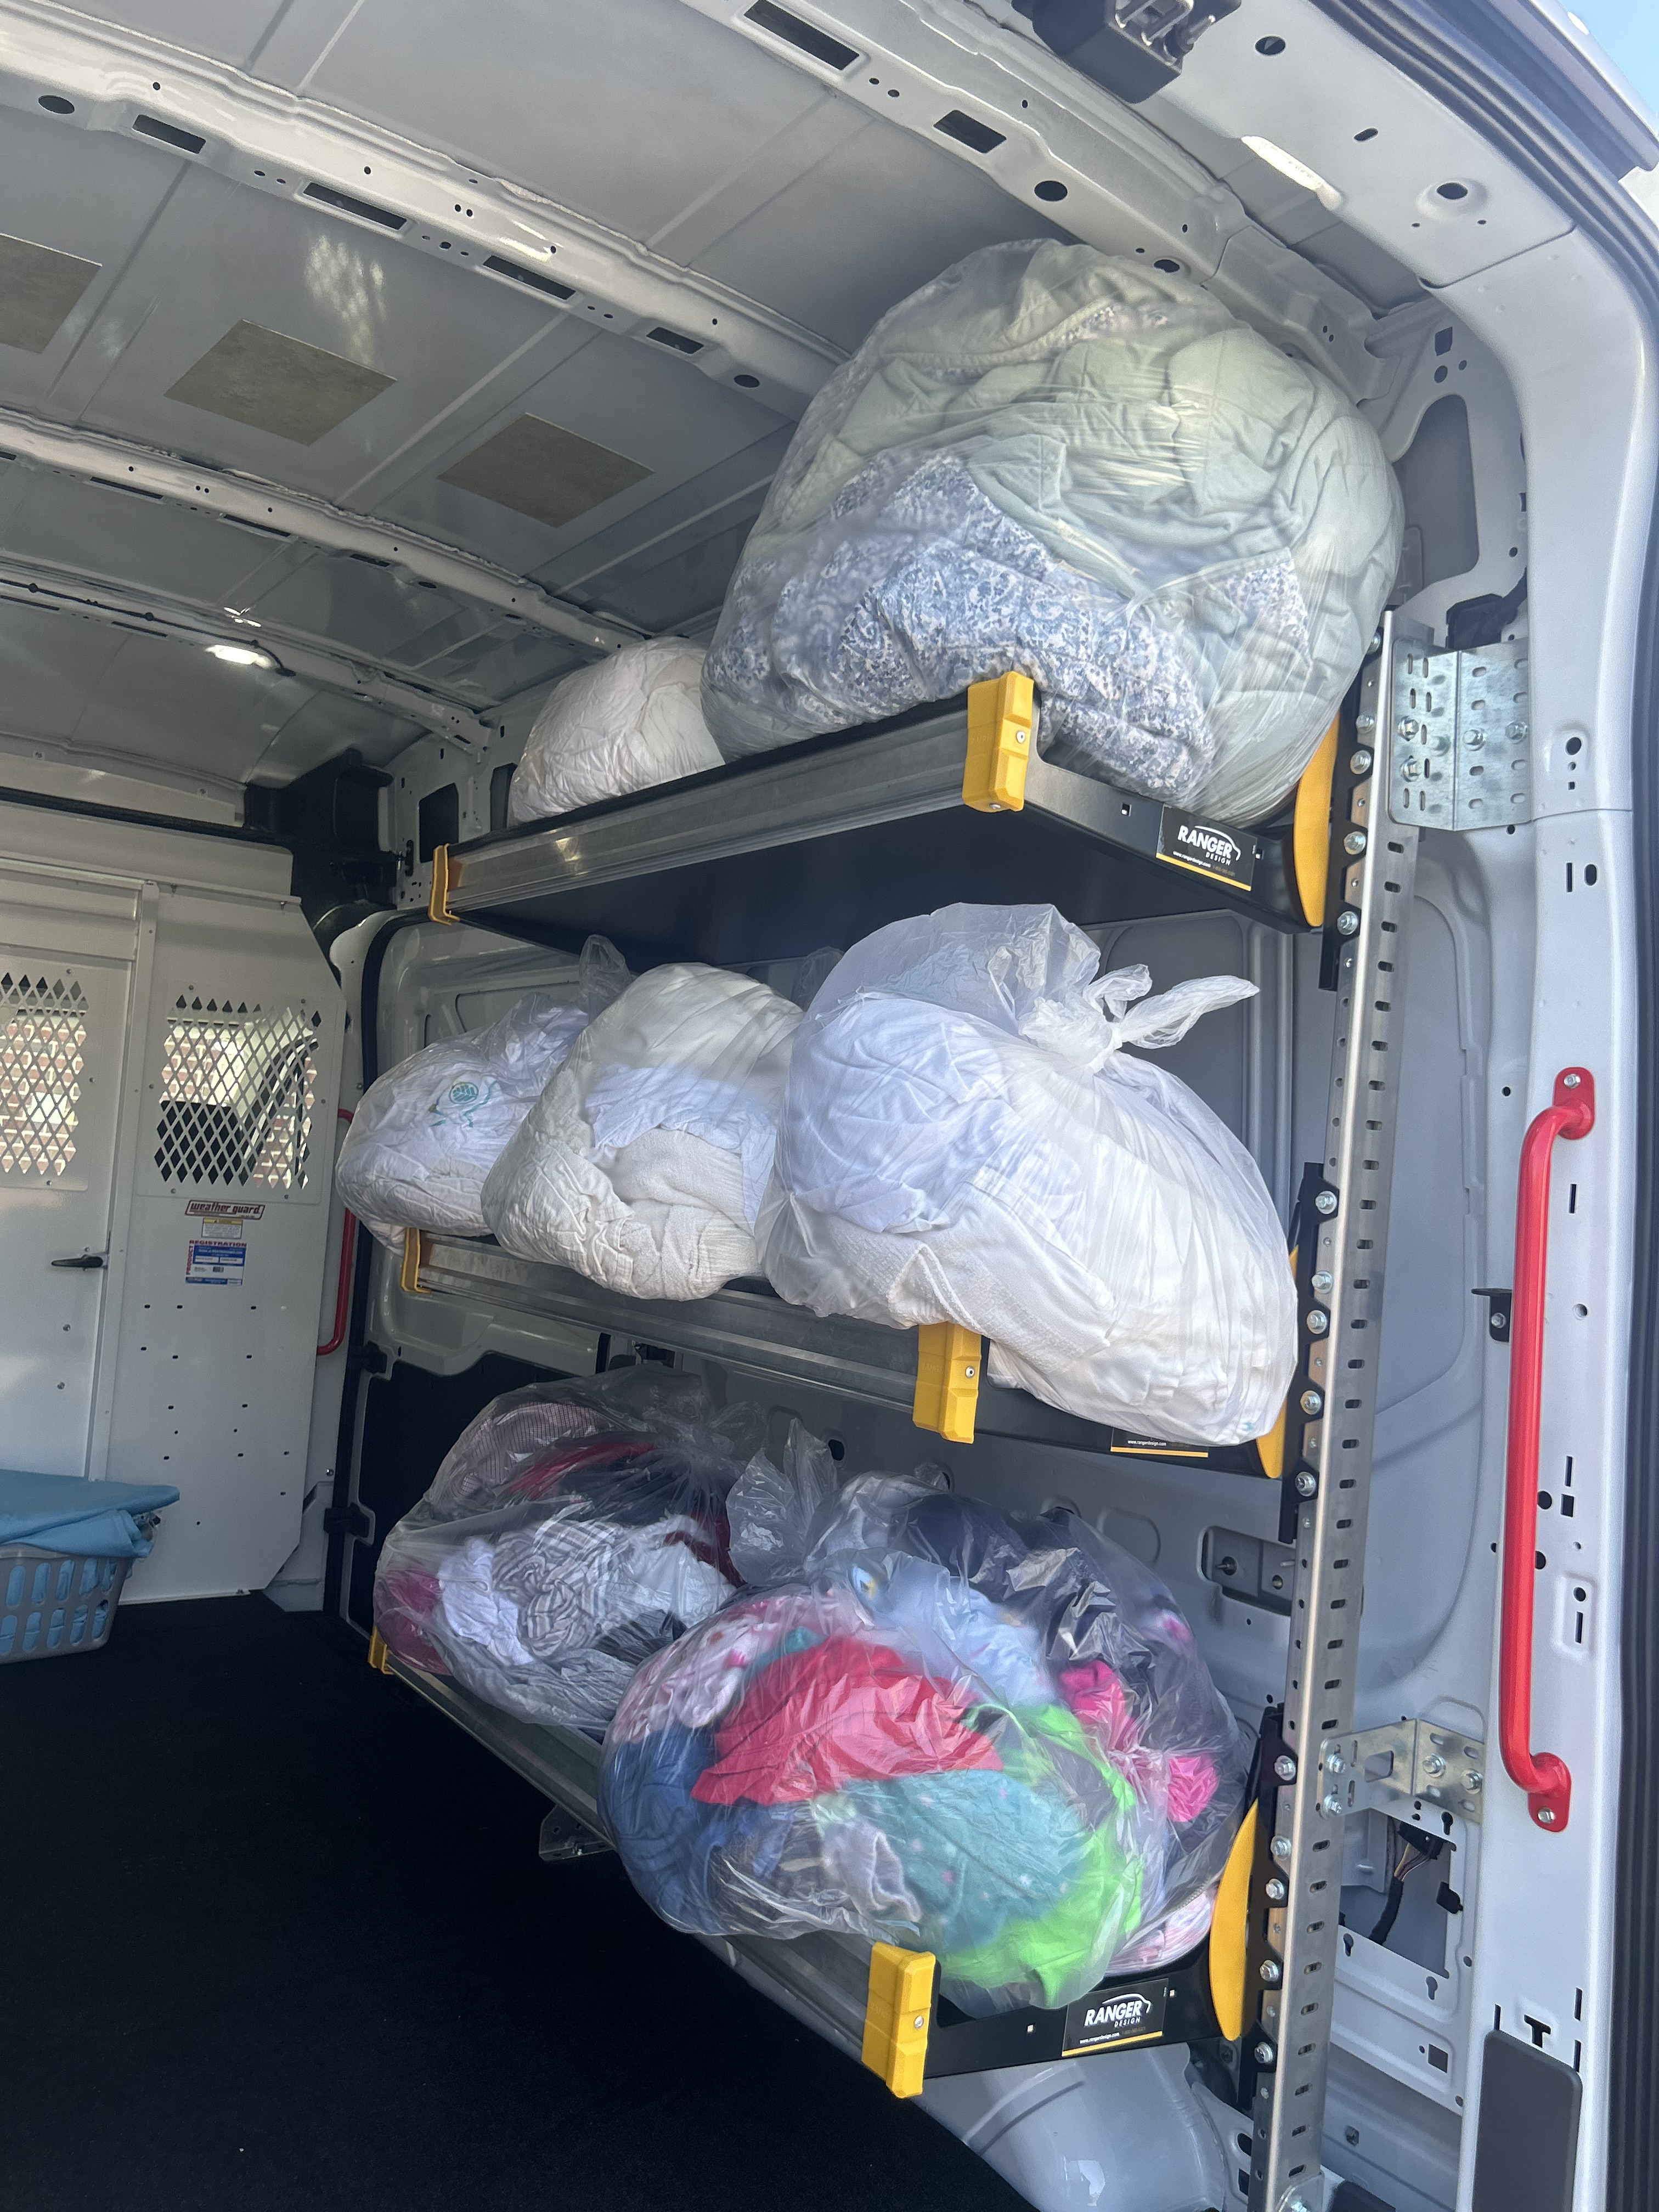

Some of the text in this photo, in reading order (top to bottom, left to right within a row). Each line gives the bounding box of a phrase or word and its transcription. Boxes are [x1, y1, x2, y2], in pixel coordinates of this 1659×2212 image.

[1177, 825, 1233, 859] RANGER
[1205, 851, 1231, 866] DESIGN
[190, 1201, 231, 1212] weather
[1084, 2000, 1142, 2027] RANGER
[1114, 2016, 1140, 2028] DESIGN
